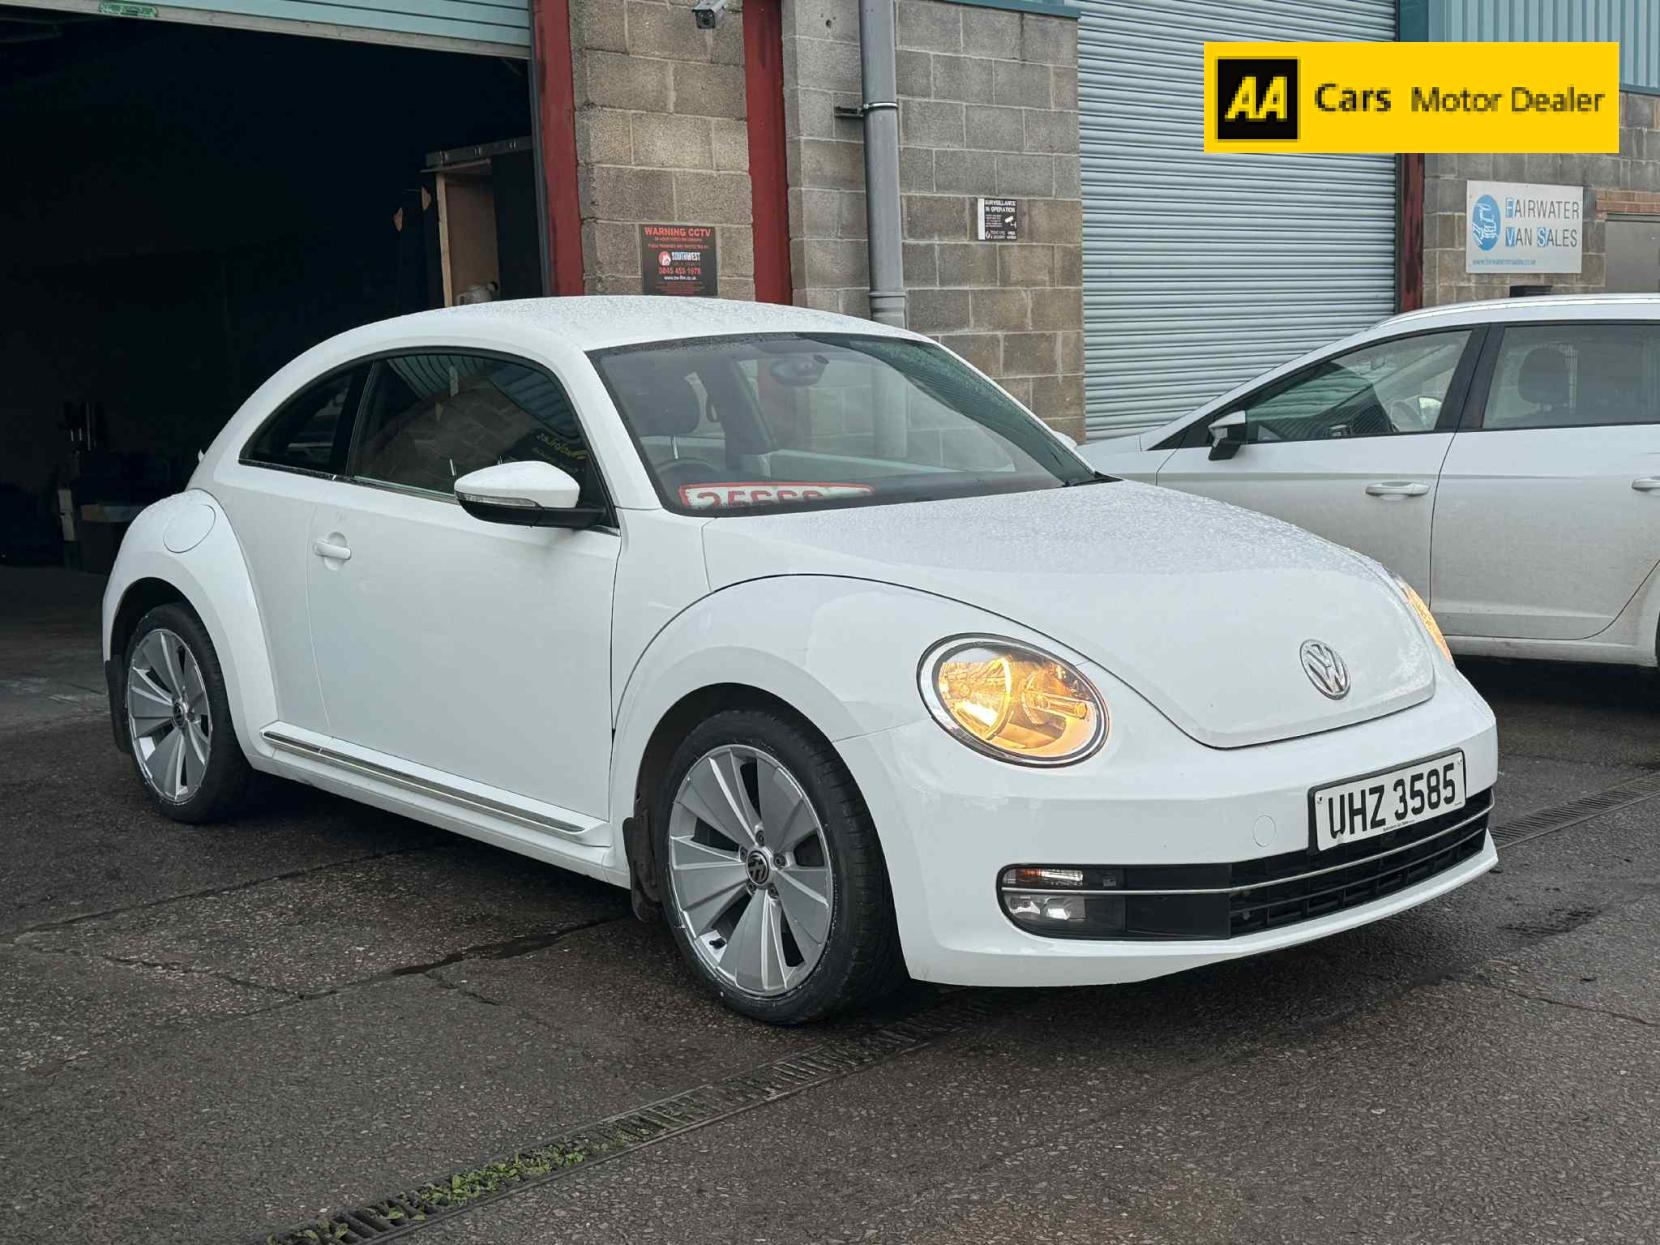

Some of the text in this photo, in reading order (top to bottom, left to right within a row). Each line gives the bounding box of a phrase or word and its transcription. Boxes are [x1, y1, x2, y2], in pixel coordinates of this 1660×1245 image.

[1504, 197, 1580, 220] FAIRWATER
[644, 227, 711, 237] WARNING CCTV
[1504, 226, 1578, 248] VAN SALES
[1327, 762, 1456, 839] UHZ 3585
